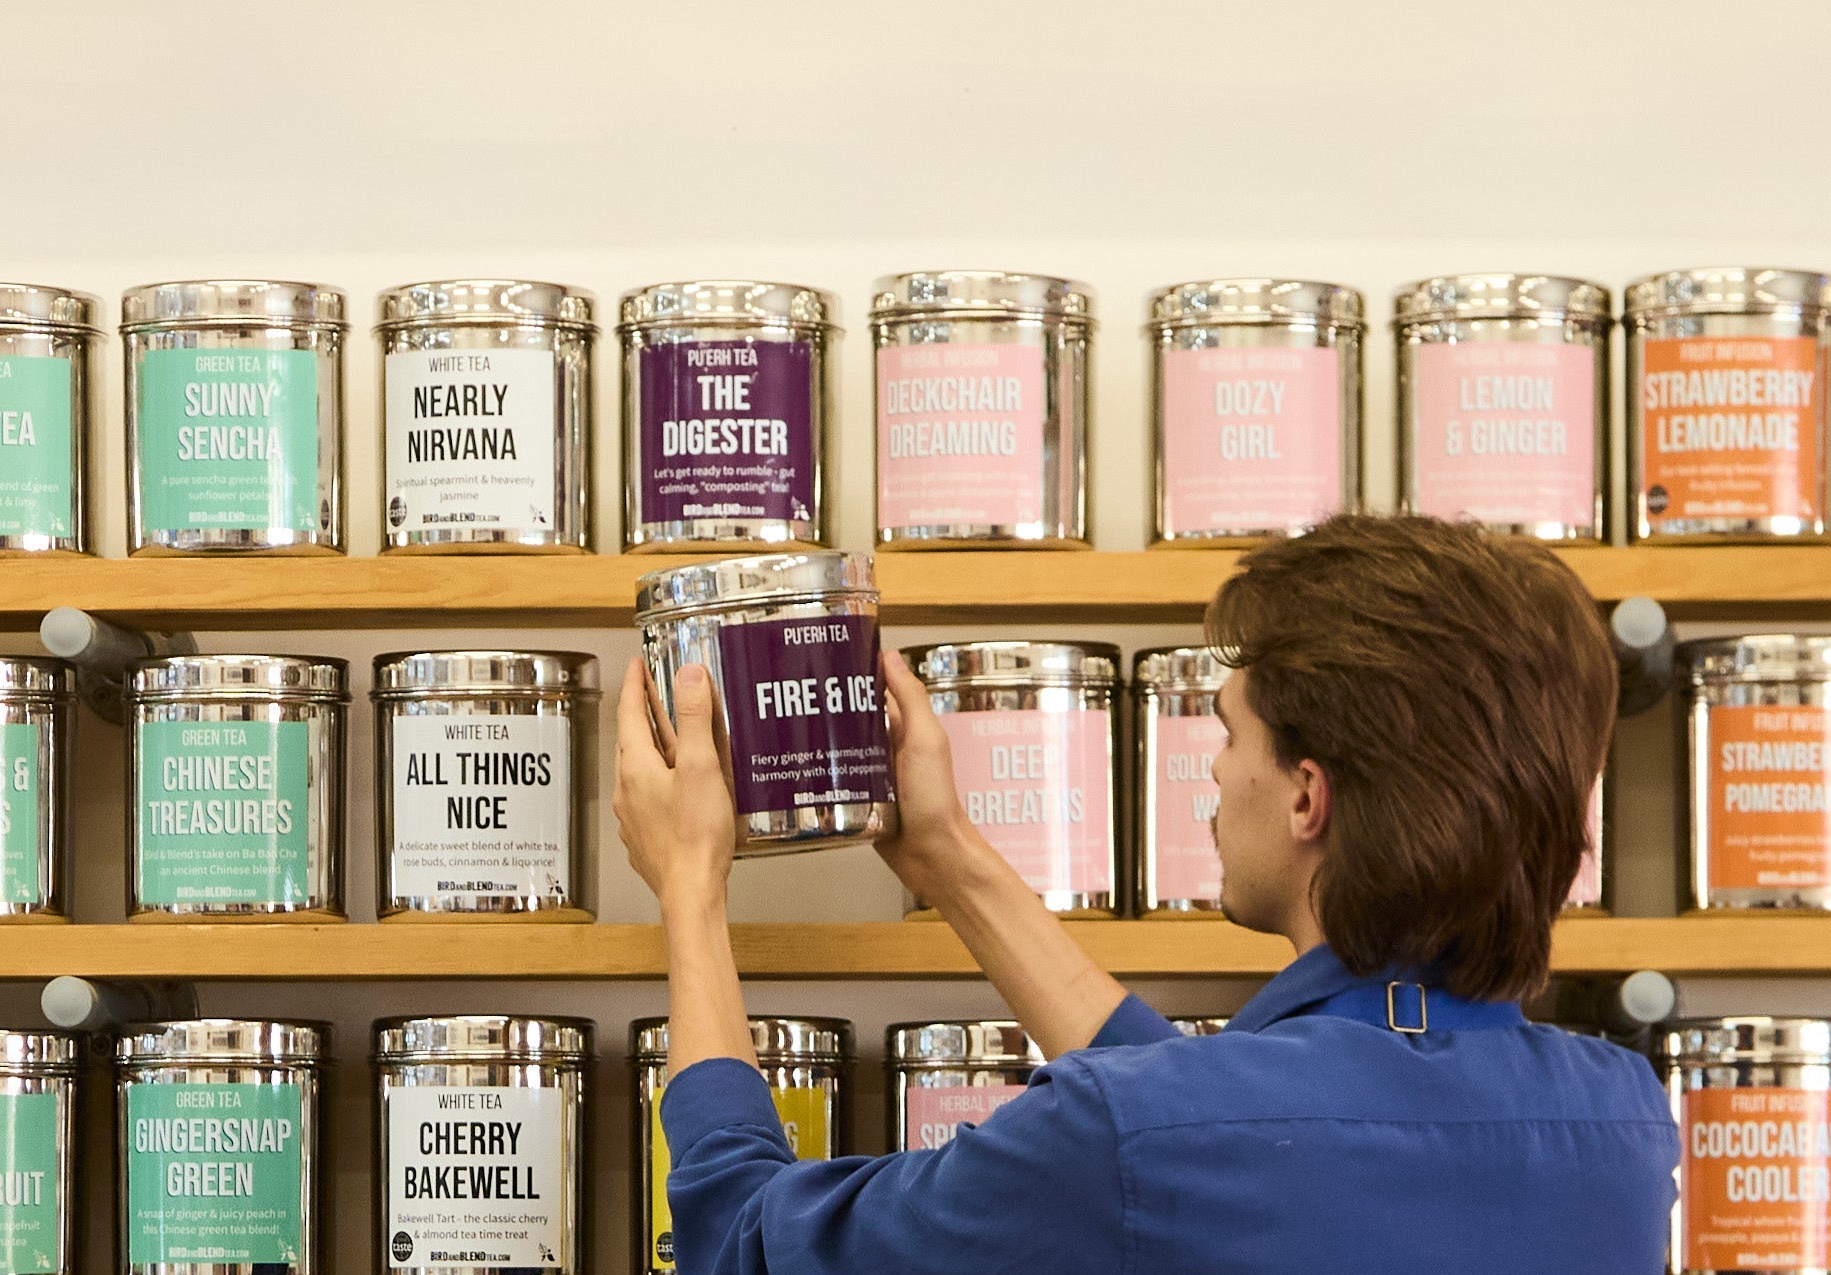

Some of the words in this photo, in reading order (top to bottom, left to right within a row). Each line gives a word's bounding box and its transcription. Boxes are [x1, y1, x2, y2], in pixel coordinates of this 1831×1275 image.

[185, 382, 270, 419] SUNNY
[413, 384, 507, 419] NEARLY
[697, 375, 751, 410] THE
[887, 377, 1022, 414] DECKCHAIR
[1215, 381, 1285, 417] DOZY
[1460, 376, 1554, 412] LEMON
[1645, 369, 1814, 408] STRAWBERRY
[177, 425, 280, 462] SENCHA
[407, 428, 517, 463] NIRVANA
[663, 419, 787, 456] DIGESTER
[890, 421, 1016, 459] DREAMING
[1221, 423, 1280, 461] GIRL
[1446, 423, 1463, 455] &
[1469, 421, 1567, 455] GINGER
[1658, 414, 1800, 452] LEMONADE
[828, 625, 849, 642] TEA
[756, 678, 819, 719] FIRE
[825, 677, 843, 714] &
[847, 676, 877, 712] ICE
[13, 757, 29, 791] &
[163, 756, 270, 792] CHINESE
[407, 753, 448, 785] ALL
[456, 753, 551, 785] THINGS
[752, 770, 801, 782] harmony
[803, 766, 826, 778] with
[149, 800, 291, 836] TREASURES
[448, 796, 507, 829] NICE
[176, 1092, 214, 1108] GREEN
[218, 1092, 241, 1108] TEA
[438, 1094, 474, 1109] WHITE
[479, 1094, 502, 1109] TEA
[135, 1118, 291, 1153] GINGERSNAP
[420, 1122, 522, 1155] CHERRY
[167, 1162, 253, 1197] GREEN
[405, 1167, 540, 1199] BAKEWELL
[1727, 1163, 1830, 1204] COOLER
[422, 1229, 458, 1239] almond
[461, 1231, 476, 1239] tea
[479, 1230, 502, 1239] time
[505, 1230, 528, 1239] treat
[436, 1214, 455, 1222] Tart
[464, 1214, 481, 1222] the
[483, 1214, 516, 1222] classic
[519, 1214, 548, 1225] cherry
